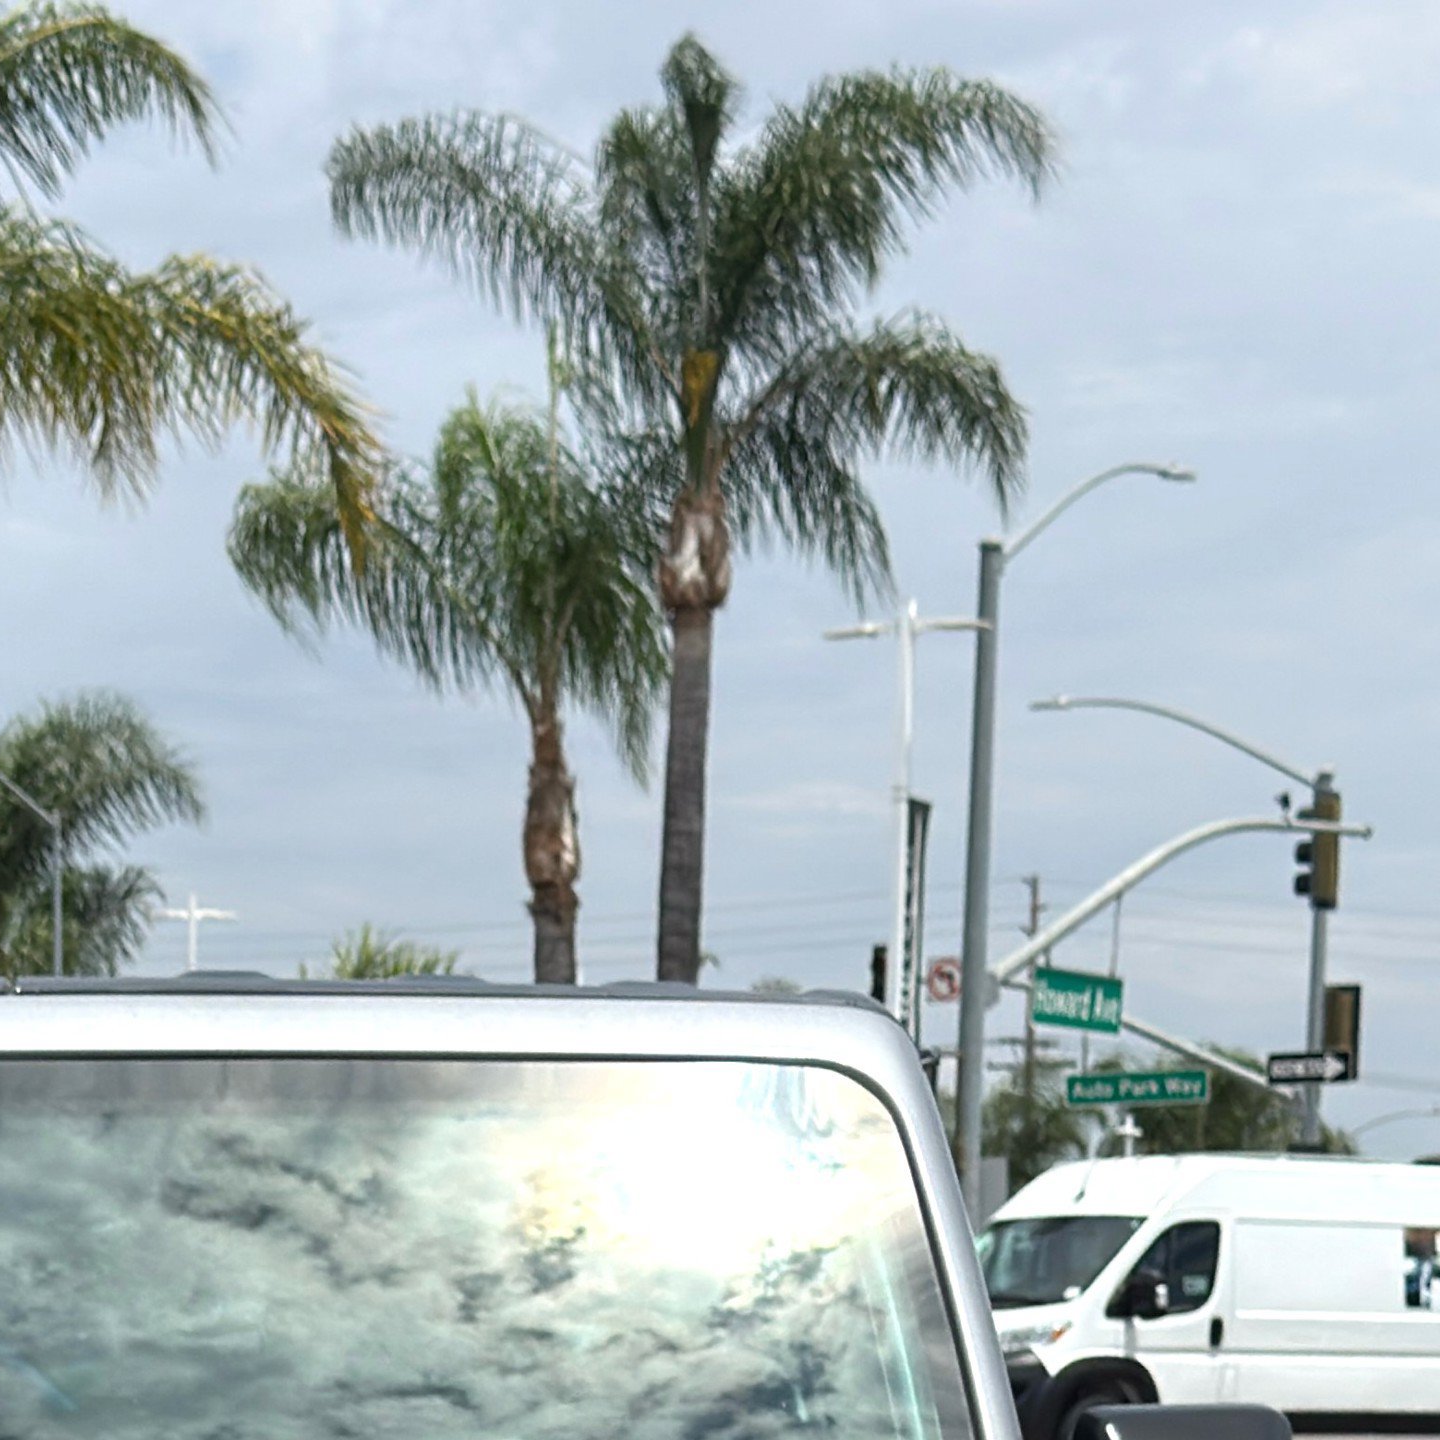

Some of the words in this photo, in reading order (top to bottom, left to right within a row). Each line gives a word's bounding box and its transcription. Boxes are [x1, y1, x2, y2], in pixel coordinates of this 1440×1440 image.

[1034, 980, 1092, 1022] Howard
[1073, 1081, 1114, 1098] Auto
[1120, 1079, 1159, 1096] Park
[1164, 1077, 1202, 1095] Way
